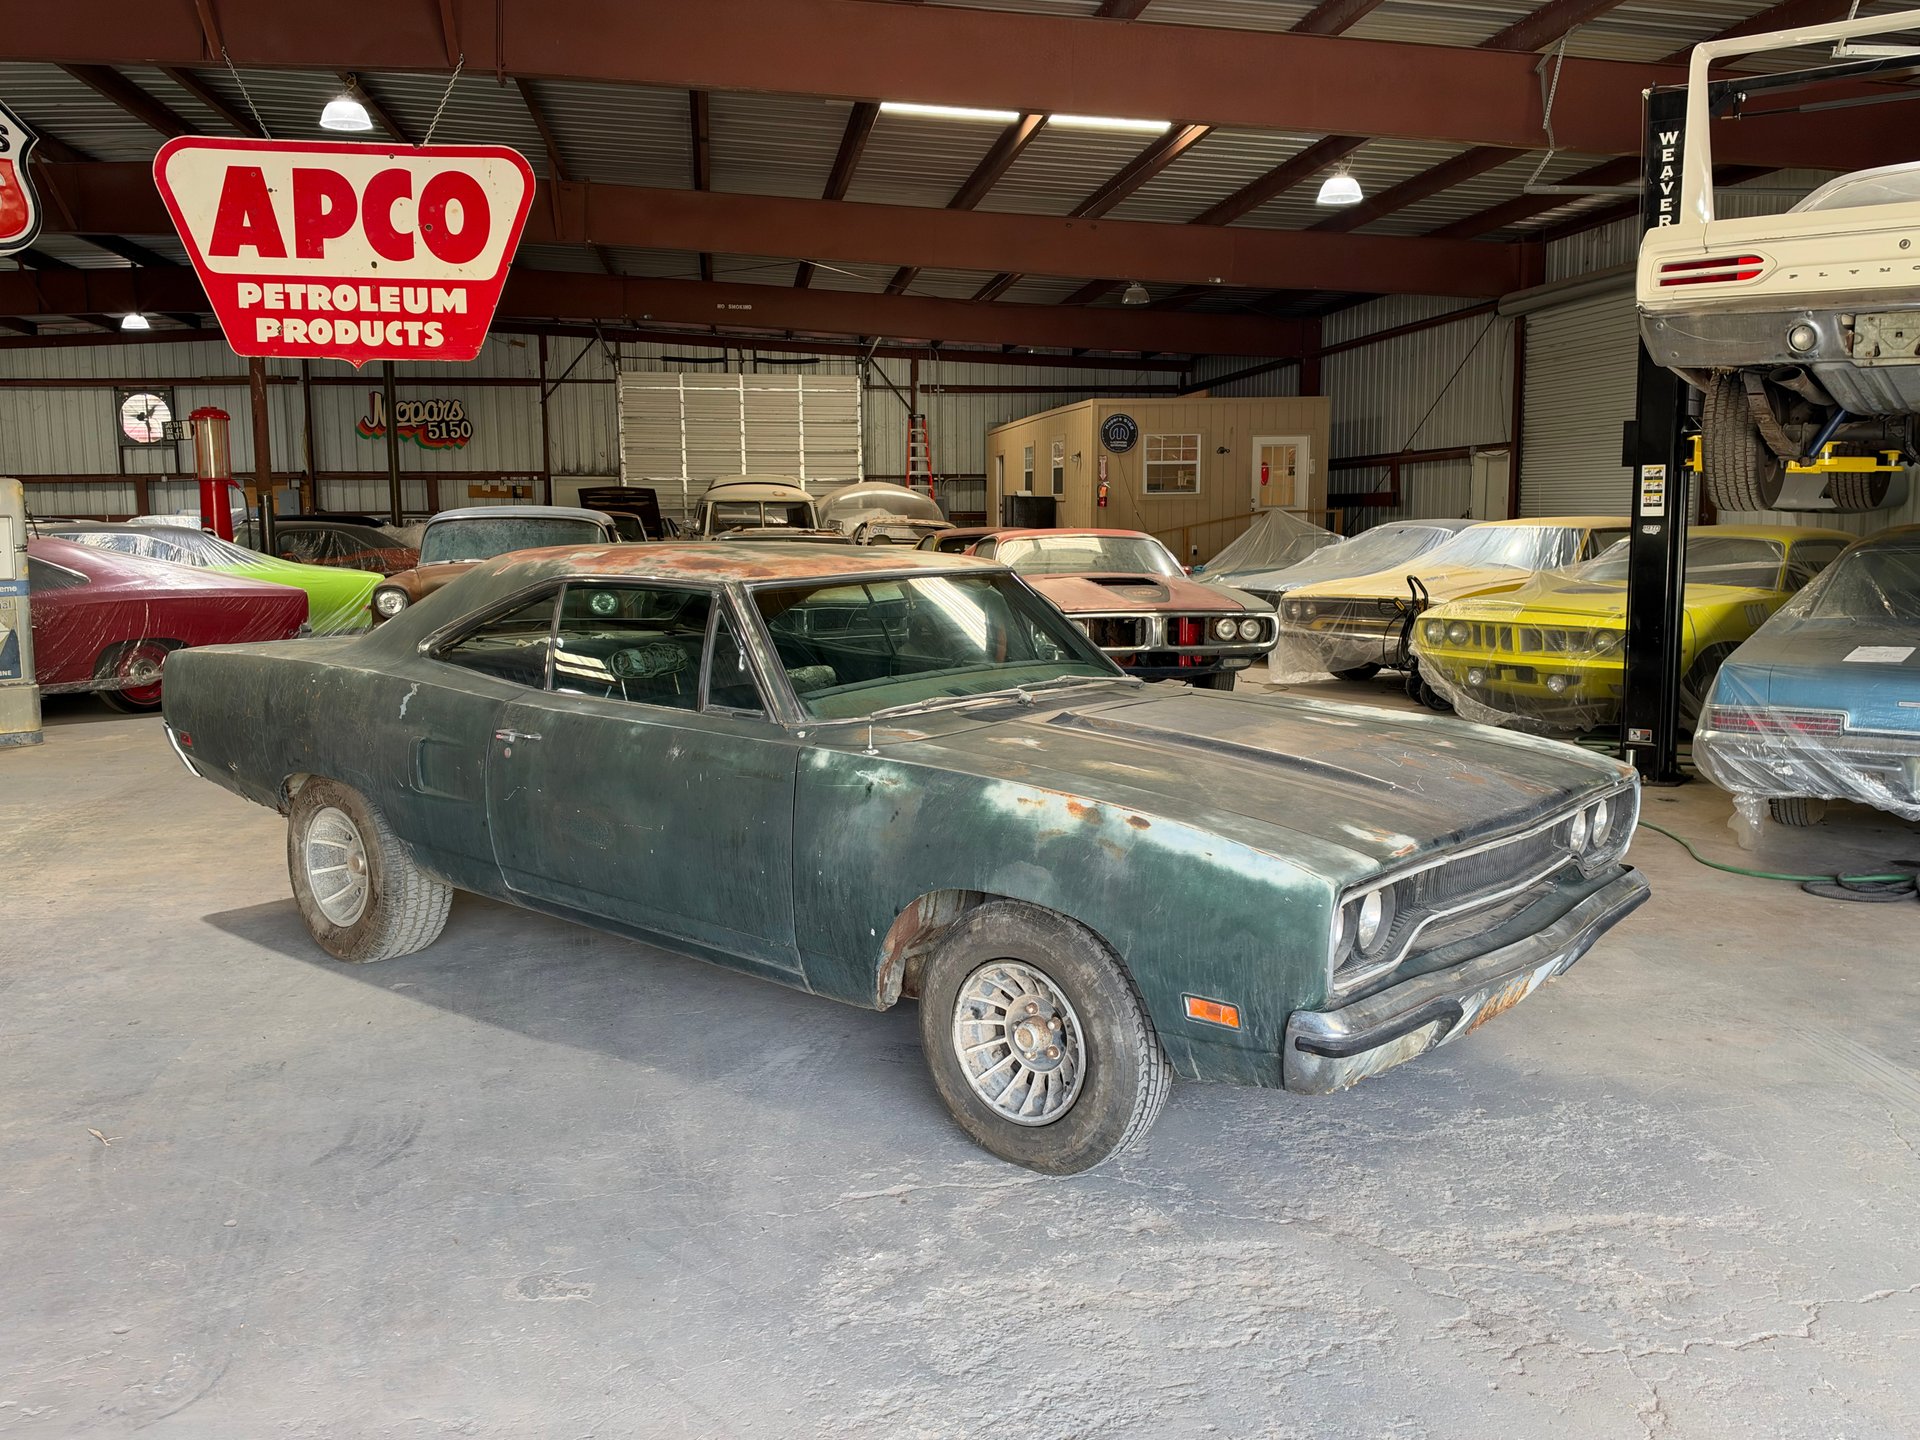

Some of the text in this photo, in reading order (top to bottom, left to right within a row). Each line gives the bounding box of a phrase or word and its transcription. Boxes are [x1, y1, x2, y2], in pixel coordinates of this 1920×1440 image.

[1659, 131, 1679, 227] WEAVER
[208, 166, 490, 264] APCO
[238, 283, 468, 313] PETROLEUM
[256, 318, 444, 346] PRODUCTS
[427, 421, 472, 440] 5150
